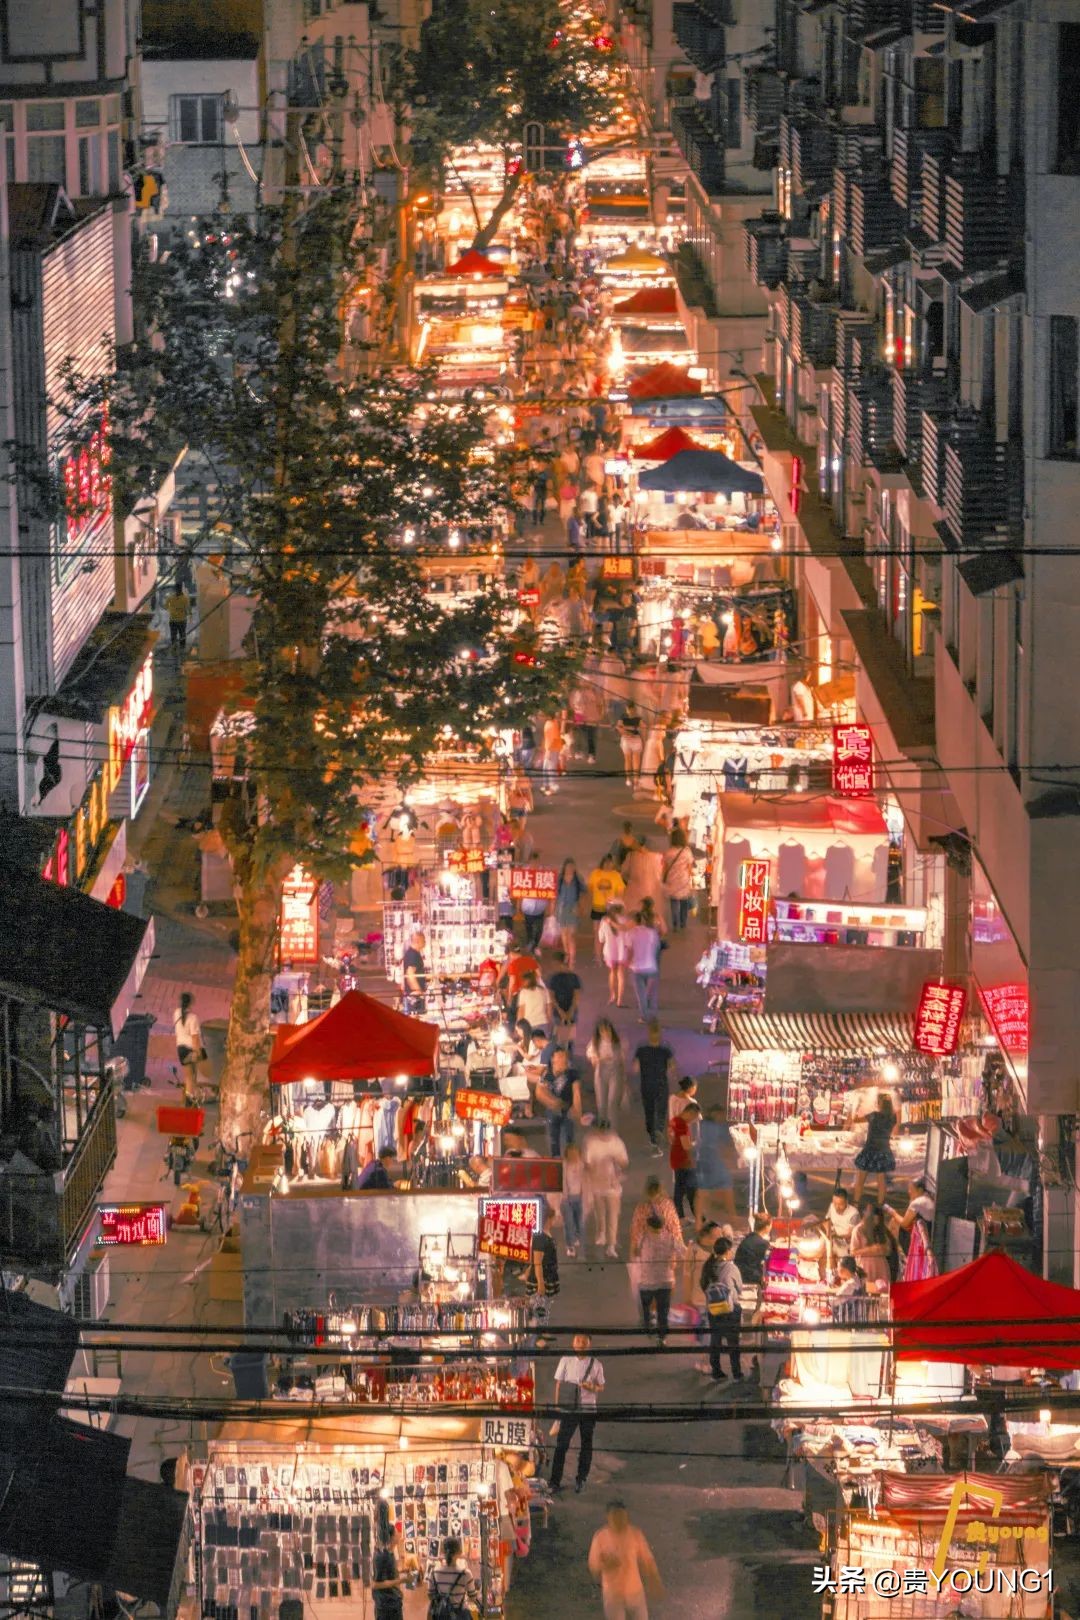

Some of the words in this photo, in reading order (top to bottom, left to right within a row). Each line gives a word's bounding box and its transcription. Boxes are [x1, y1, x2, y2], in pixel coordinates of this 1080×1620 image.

[512, 870, 555, 889] 贴膜
[743, 863, 763, 939] 化妆品
[486, 1202, 536, 1227] 手机维修
[483, 1218, 529, 1247] 贴膜
[485, 1420, 527, 1446] 贴膜
